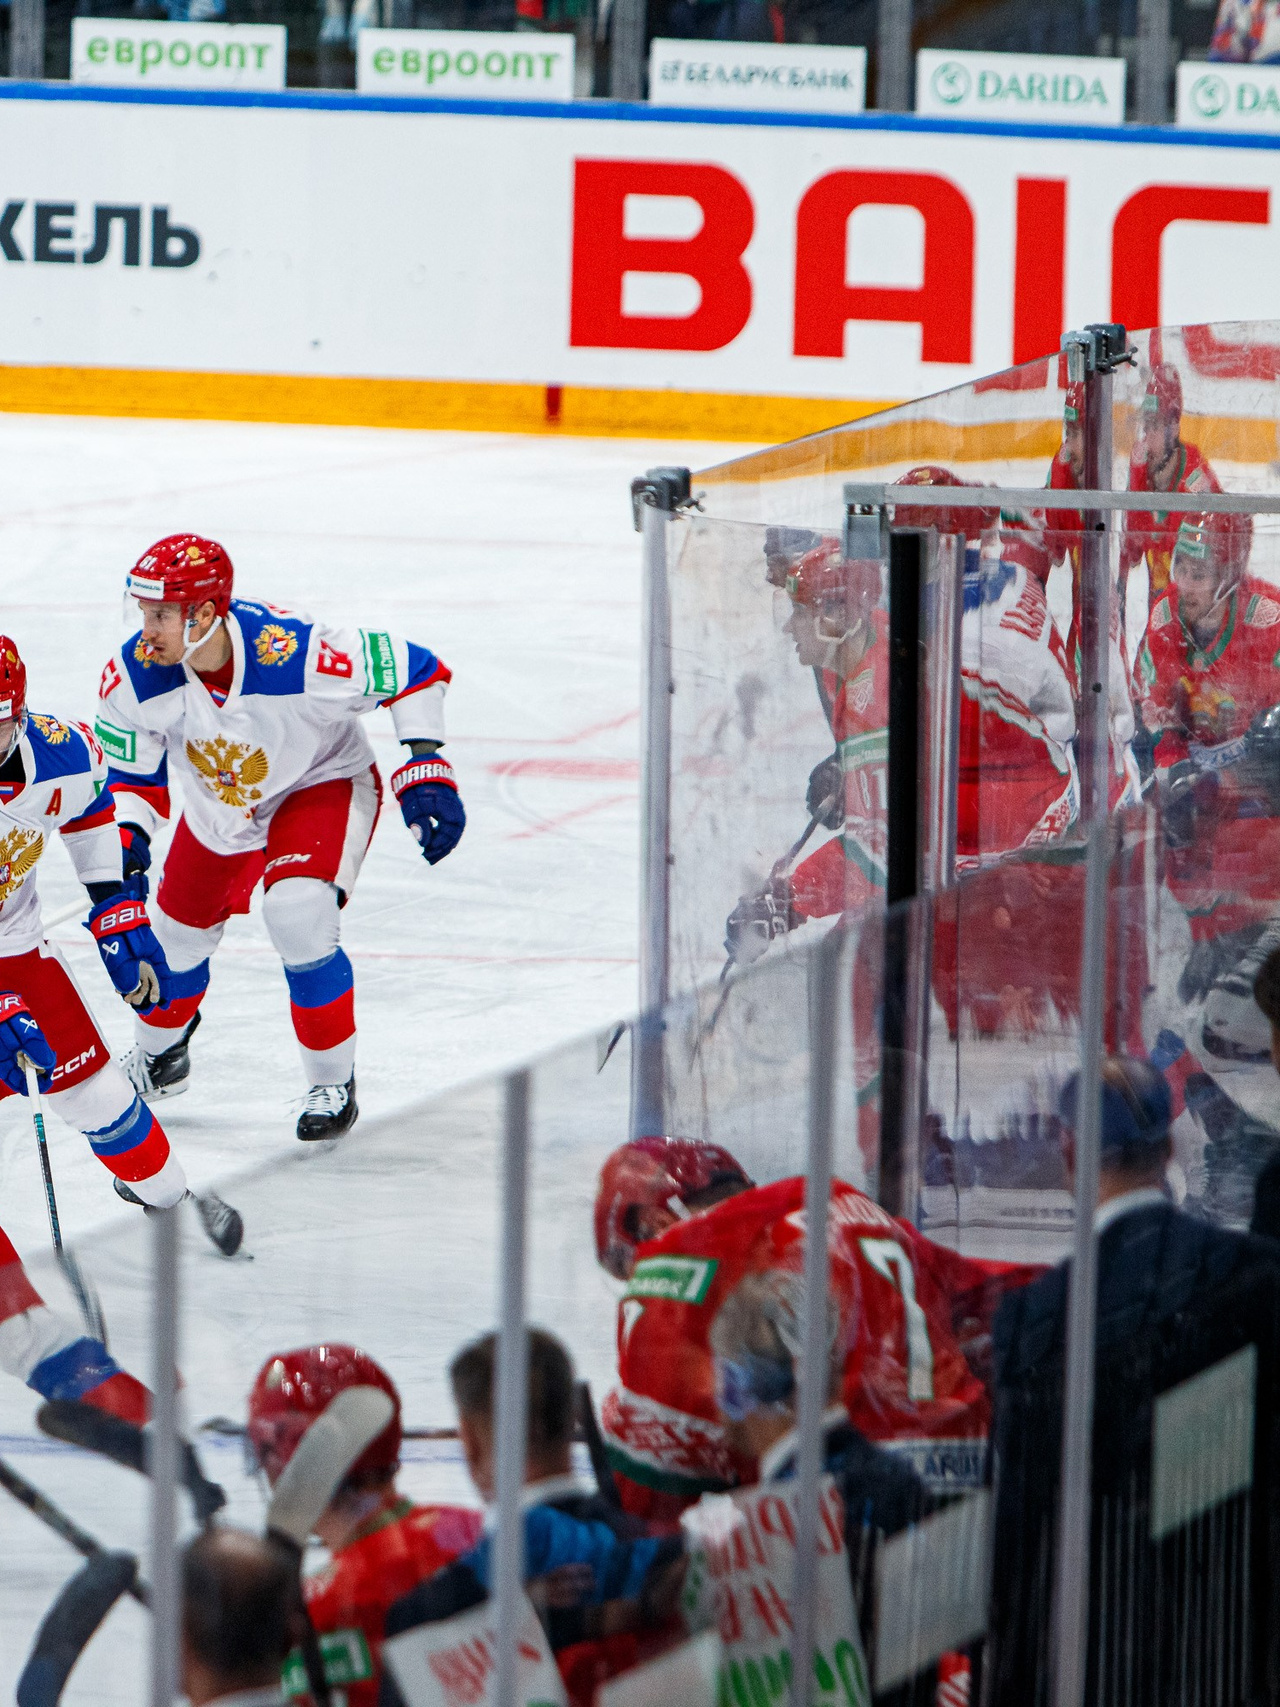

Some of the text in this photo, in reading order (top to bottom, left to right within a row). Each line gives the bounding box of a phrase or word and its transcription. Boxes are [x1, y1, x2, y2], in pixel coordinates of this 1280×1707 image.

[87, 36, 271, 74] евроопт
[372, 46, 560, 84] евроопт
[684, 62, 854, 90] БЕЛАРУСБАНК
[976, 68, 1109, 106] DARIDA
[44, 787, 62, 816] A
[50, 1044, 96, 1081] CCM
